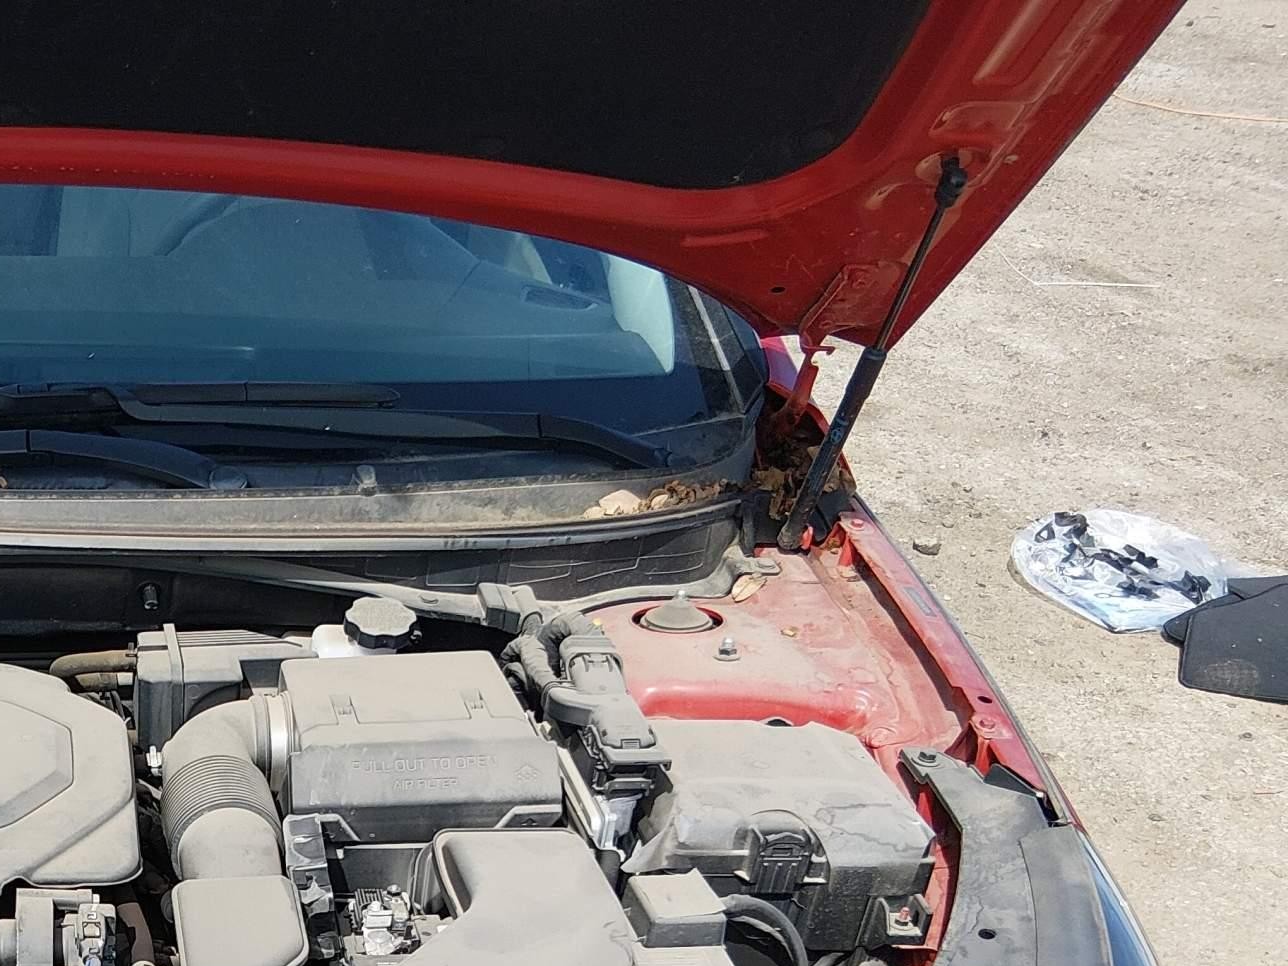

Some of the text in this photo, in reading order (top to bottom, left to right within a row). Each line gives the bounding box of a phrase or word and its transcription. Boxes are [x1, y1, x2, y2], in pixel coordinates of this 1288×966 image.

[393, 756, 427, 773] OUT
[431, 755, 452, 770] TO
[455, 753, 498, 770] OPEN
[392, 775, 459, 792] AIR FILTER
